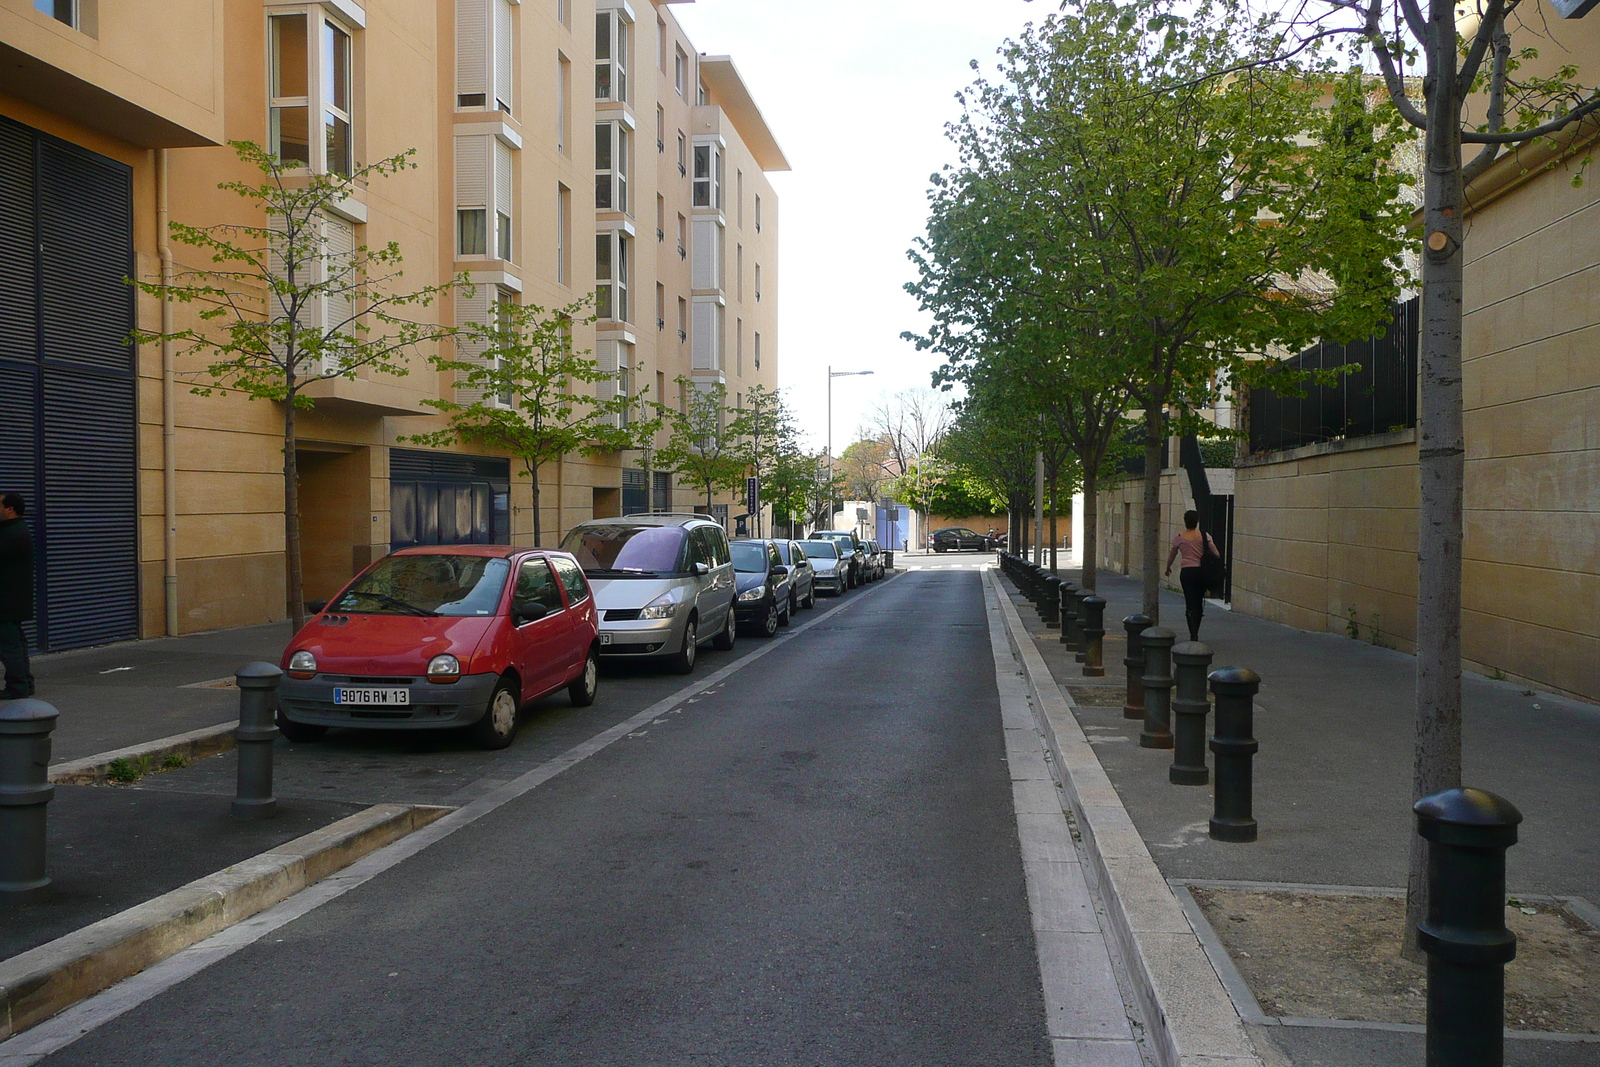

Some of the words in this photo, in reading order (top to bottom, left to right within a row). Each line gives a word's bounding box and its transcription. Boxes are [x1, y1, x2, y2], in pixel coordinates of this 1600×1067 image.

[600, 634, 610, 644] 13
[341, 690, 370, 703] 9076
[373, 690, 387, 703] RW
[392, 690, 406, 703] 13
